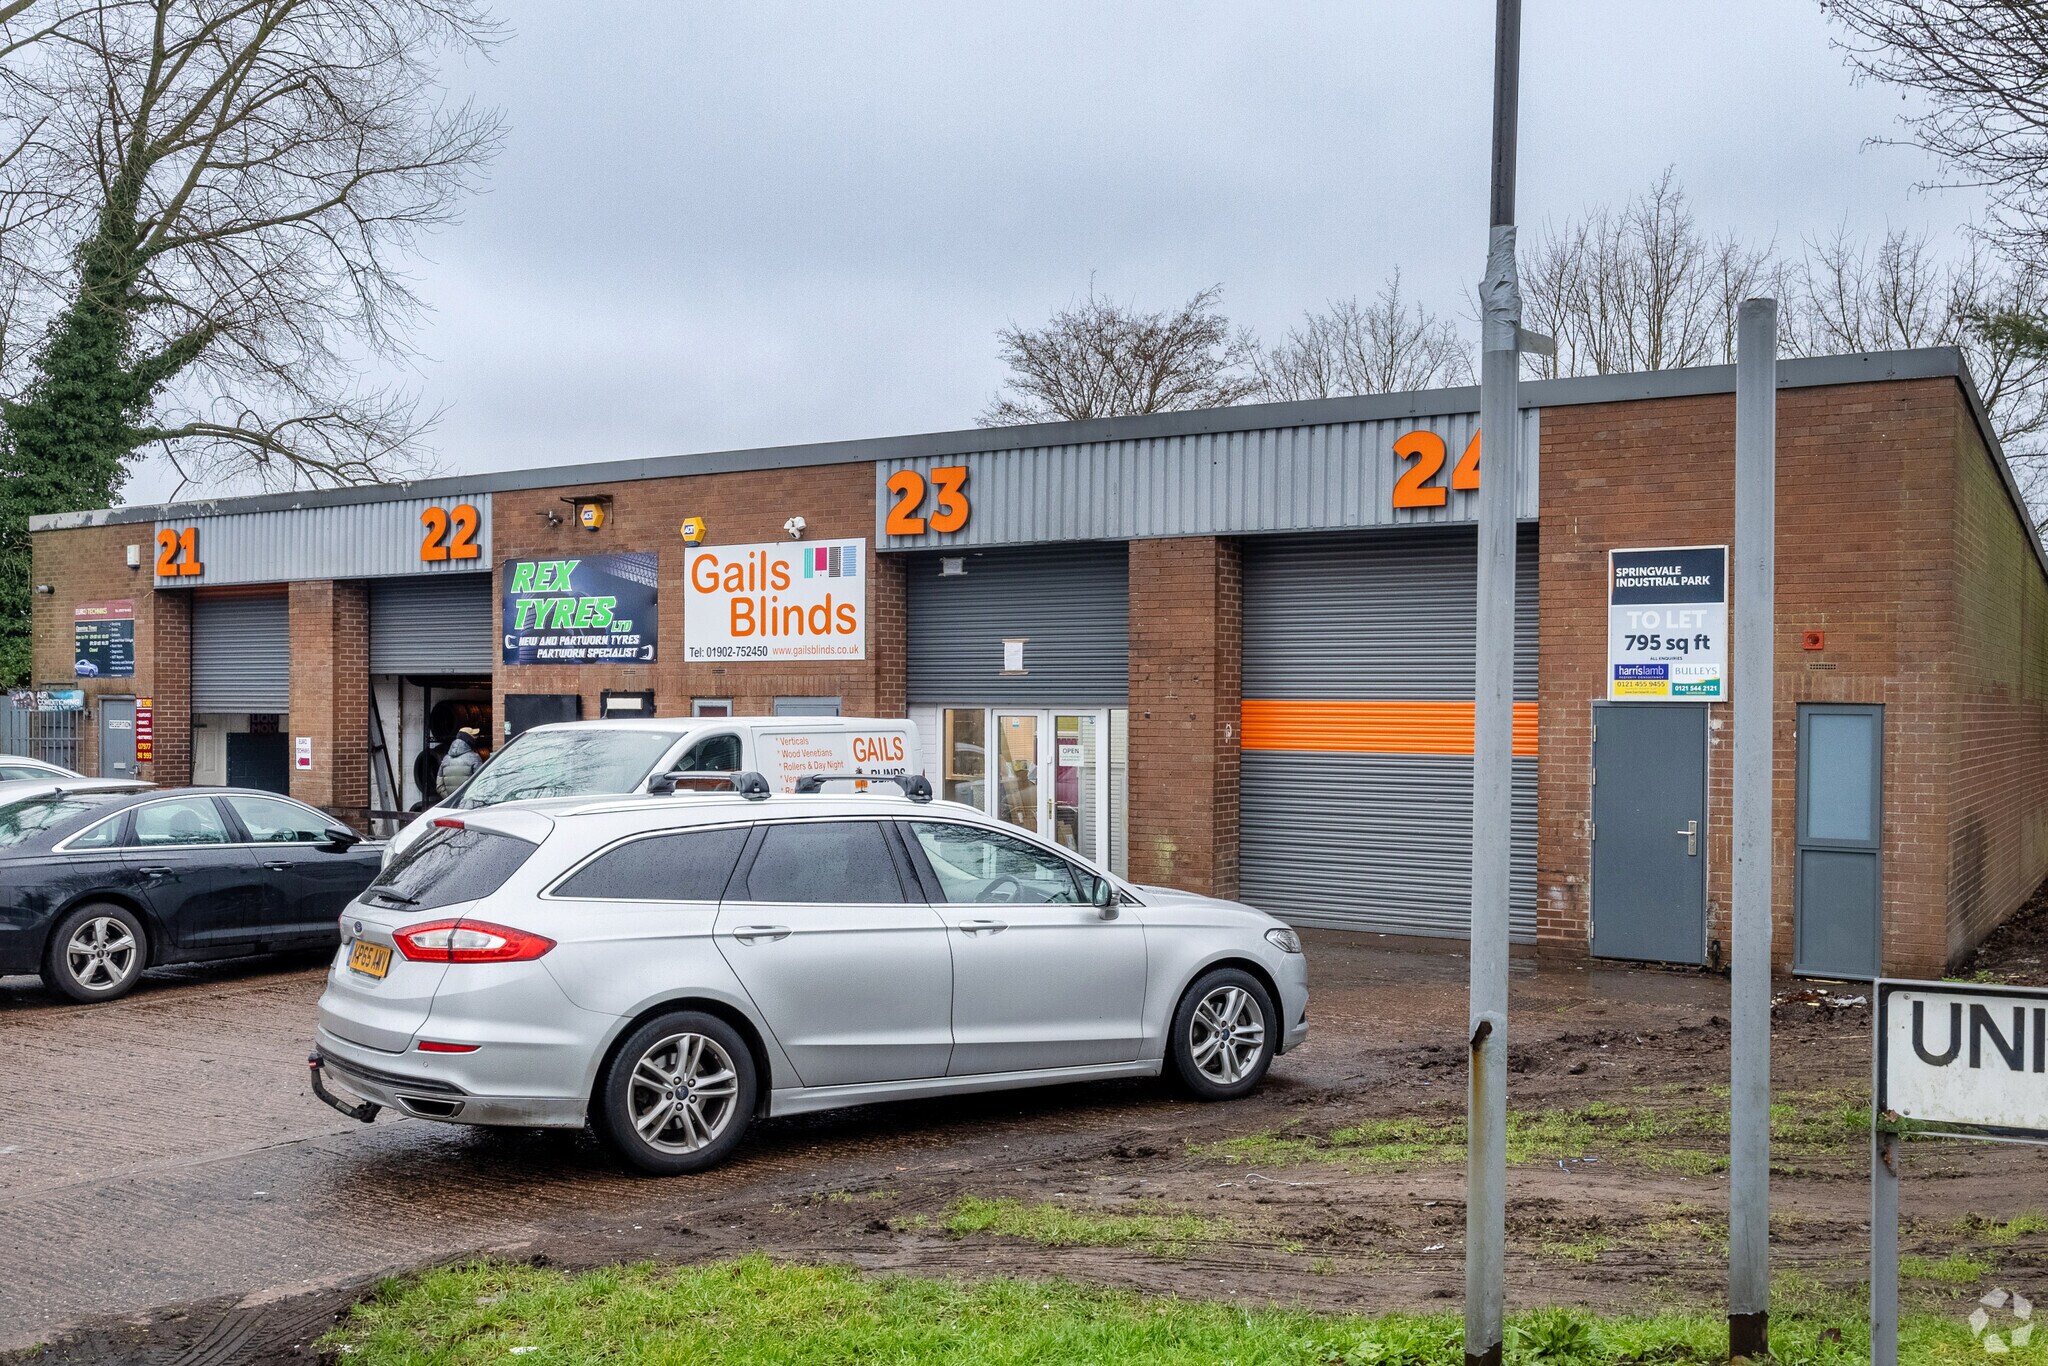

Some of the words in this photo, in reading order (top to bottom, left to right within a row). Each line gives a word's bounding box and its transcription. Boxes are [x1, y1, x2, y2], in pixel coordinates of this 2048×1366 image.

[1391, 428, 1480, 508] 24
[886, 466, 970, 536] 23
[420, 504, 480, 562] 22
[157, 527, 203, 577] 21
[511, 559, 582, 593] REX
[691, 550, 791, 594] Gails
[1616, 566, 1682, 577] SPRINGVALE
[1616, 577, 1679, 587] INDUSTRIAL
[1681, 575, 1711, 586] PARK
[514, 596, 617, 630] TYRES
[611, 620, 632, 632] LTD
[730, 592, 857, 638] Blinds
[1627, 610, 1661, 629] TO
[1666, 610, 1708, 629] LET
[518, 636, 538, 646] NEW
[539, 635, 558, 646] AND
[559, 635, 609, 646] PARTWORN
[611, 634, 640, 645] TYRES
[1624, 634, 1661, 651] 795
[1666, 637, 1689, 654] sq
[1694, 634, 1710, 650] ft
[537, 648, 586, 659] PARTWORN
[587, 647, 639, 658] SPECIALIST
[689, 646, 704, 658] Tel:
[706, 645, 768, 658] 01902-752450
[772, 644, 860, 657] www.gailsblinds.co.uk
[1618, 665, 1665, 676] harrislamb
[1675, 667, 1717, 675] BULLEYS
[252, 724, 278, 733] MOLY
[780, 737, 809, 746] Verticals
[853, 736, 905, 763] GAILS
[782, 749, 801, 758] Wood
[802, 748, 833, 757] Venetians
[783, 762, 806, 771] Rollers
[808, 761, 813, 770] &
[814, 761, 826, 771] Day
[827, 760, 844, 771] Night
[1911, 1000, 2046, 1074] UNI
